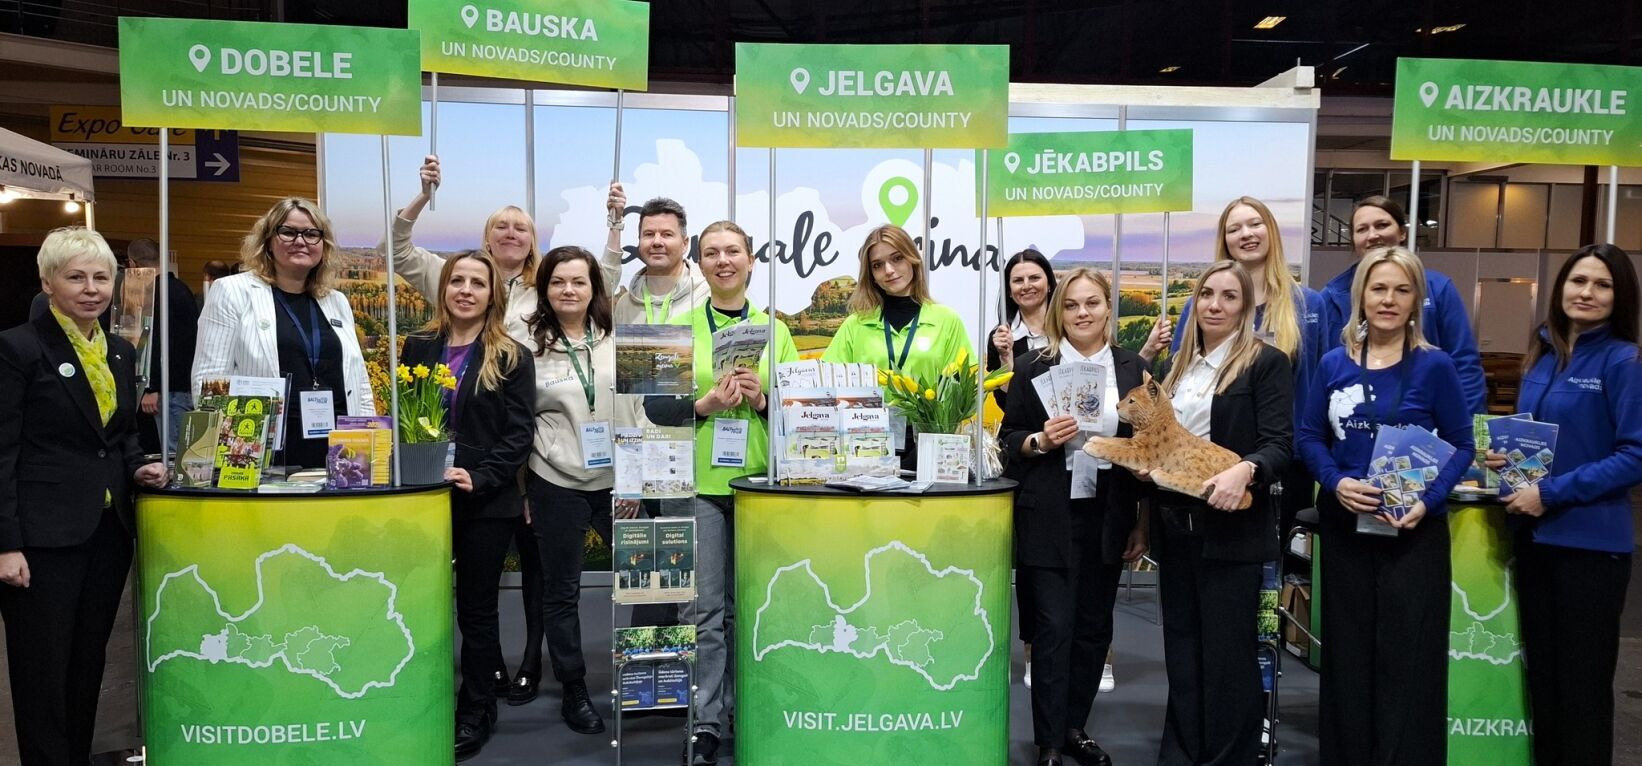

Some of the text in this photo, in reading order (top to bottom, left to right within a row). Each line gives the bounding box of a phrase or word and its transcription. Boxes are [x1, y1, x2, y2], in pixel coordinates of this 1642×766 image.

[486, 9, 598, 41] BAUSKA
[221, 48, 353, 79] DOBELE
[442, 41, 616, 71] UN NOVADS/COUNTY
[819, 70, 954, 96] JELGAVA
[162, 89, 381, 113] UN NOVADS/COUNTY
[1444, 85, 1627, 115] AIZKRAUKLE
[58, 112, 121, 140] Expo
[773, 111, 972, 129] UN NOVADS/COUNTY
[1428, 125, 1614, 146] UN NOVADS/COUNTY
[63, 148, 126, 160] EMINĀRU
[129, 148, 161, 160] ZĀLE
[183, 151, 190, 161] 3
[1026, 149, 1164, 175] JĒKABPILS
[21, 162, 64, 183] NOVADĀ
[104, 164, 135, 173] ROOM
[1005, 183, 1164, 200] UN NOVADS/COUNTY
[801, 411, 830, 420] Jelgava
[852, 412, 880, 421] Jelgava
[180, 719, 366, 745] VISITDOBELE.LV
[783, 710, 964, 732] VISIT.JELGAVA.LV
